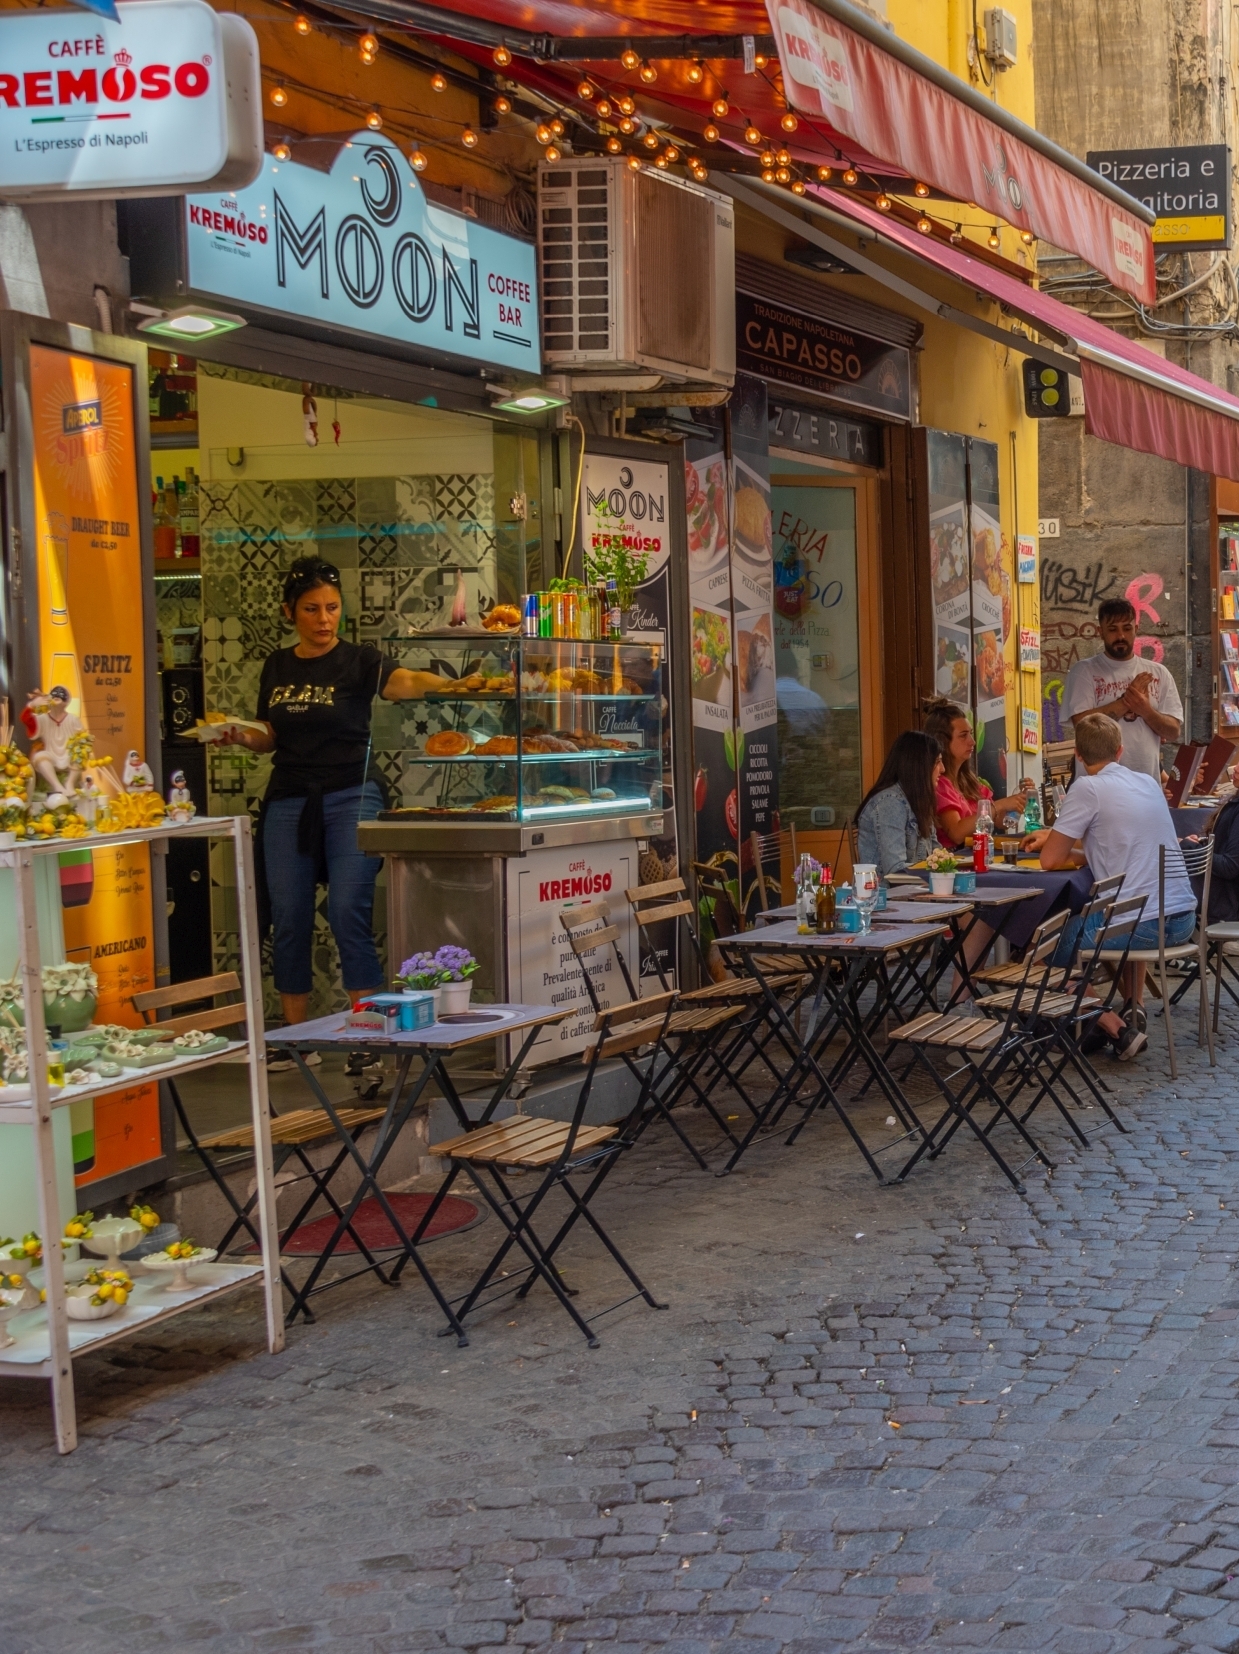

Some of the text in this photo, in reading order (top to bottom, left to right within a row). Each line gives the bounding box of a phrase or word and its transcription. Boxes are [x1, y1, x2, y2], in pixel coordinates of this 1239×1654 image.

[48, 34, 105, 58] CAFFÈ
[0, 62, 210, 109] REMOSO
[15, 131, 149, 153] L'Espresso di Napoli
[1099, 157, 1215, 181] Pizzeria e
[220, 199, 238, 212] CAFFÈ
[1140, 190, 1219, 212] gitoria
[190, 204, 269, 244] KREMOSO
[1154, 222, 1189, 236] asso
[273, 187, 481, 340] MOON
[488, 273, 531, 303] COFFEE
[498, 303, 522, 327] BAR
[754, 303, 855, 347] TRADIZIONE NAPOLETANA
[745, 321, 862, 380] CAPASSO
[759, 363, 775, 376] SAN
[777, 369, 803, 383] BIAGIO
[804, 376, 817, 387] DEI
[67, 407, 99, 429] APEROL
[774, 406, 865, 455] ZZERIA
[56, 425, 112, 466] Spritz
[586, 486, 665, 523] MOON
[72, 516, 130, 537] DRAUGHT BEER
[708, 572, 728, 590] CAPRESE
[742, 575, 771, 604] PIZZA FRITTA
[935, 600, 955, 615] CORONA
[628, 609, 659, 630] Kinder
[808, 620, 831, 637] Pizza
[84, 655, 132, 674] SPRITZ
[602, 704, 617, 713] CAFFÈ
[705, 704, 729, 720] INSALATA
[599, 713, 639, 734] Nocciola
[749, 744, 768, 754] CICCIOLI
[750, 757, 769, 768] RICOTTA
[746, 771, 773, 782] POMODORO
[749, 785, 770, 796] PROVOLA
[752, 798, 769, 810] SALAME
[755, 812, 765, 823] PEPE
[569, 859, 586, 872] CAFFÈ
[539, 872, 612, 902] KREMOSO
[94, 936, 147, 958] AMERICANO
[551, 932, 558, 946] è
[655, 949, 669, 957] OFFEE
[543, 958, 612, 986] Prevalenteente di
[551, 981, 606, 1008] qualità Arbica
[576, 1000, 610, 1018] conteuto
[350, 1021, 383, 1029] KREMOSO
[560, 1019, 595, 1041] di caffein
